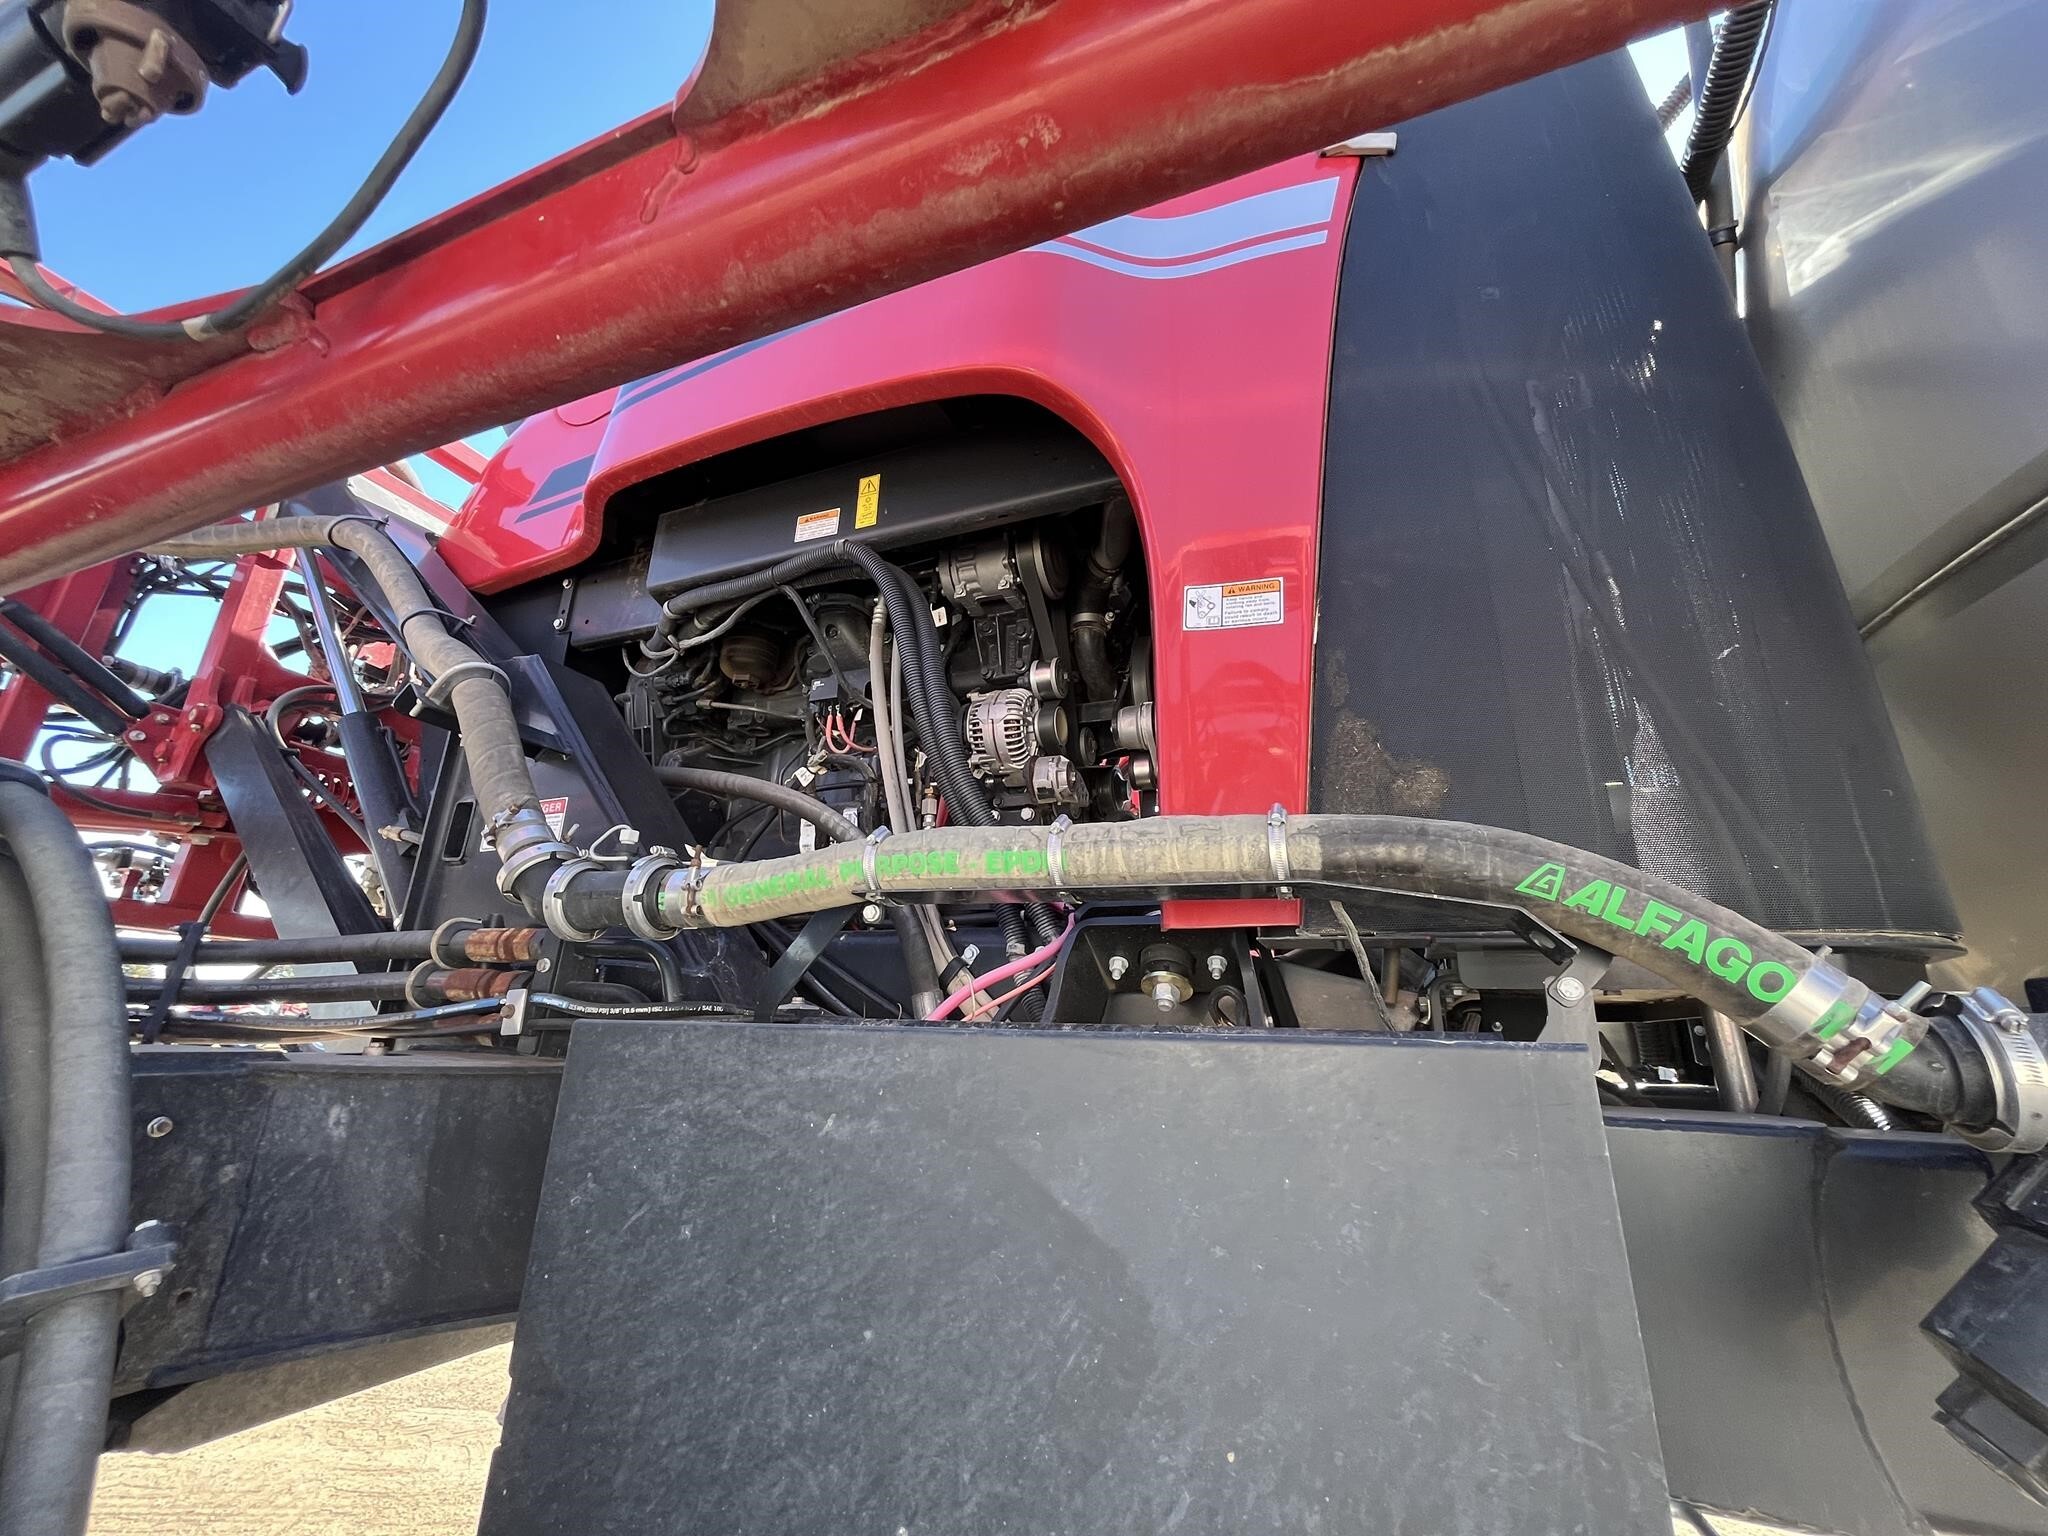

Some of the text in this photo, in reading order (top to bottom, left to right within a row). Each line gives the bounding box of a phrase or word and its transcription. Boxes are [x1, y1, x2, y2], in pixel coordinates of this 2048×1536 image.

[1238, 583, 1275, 593] WARNING
[723, 866, 832, 908] GENERAL
[1562, 879, 1798, 1003] ALFAGO
